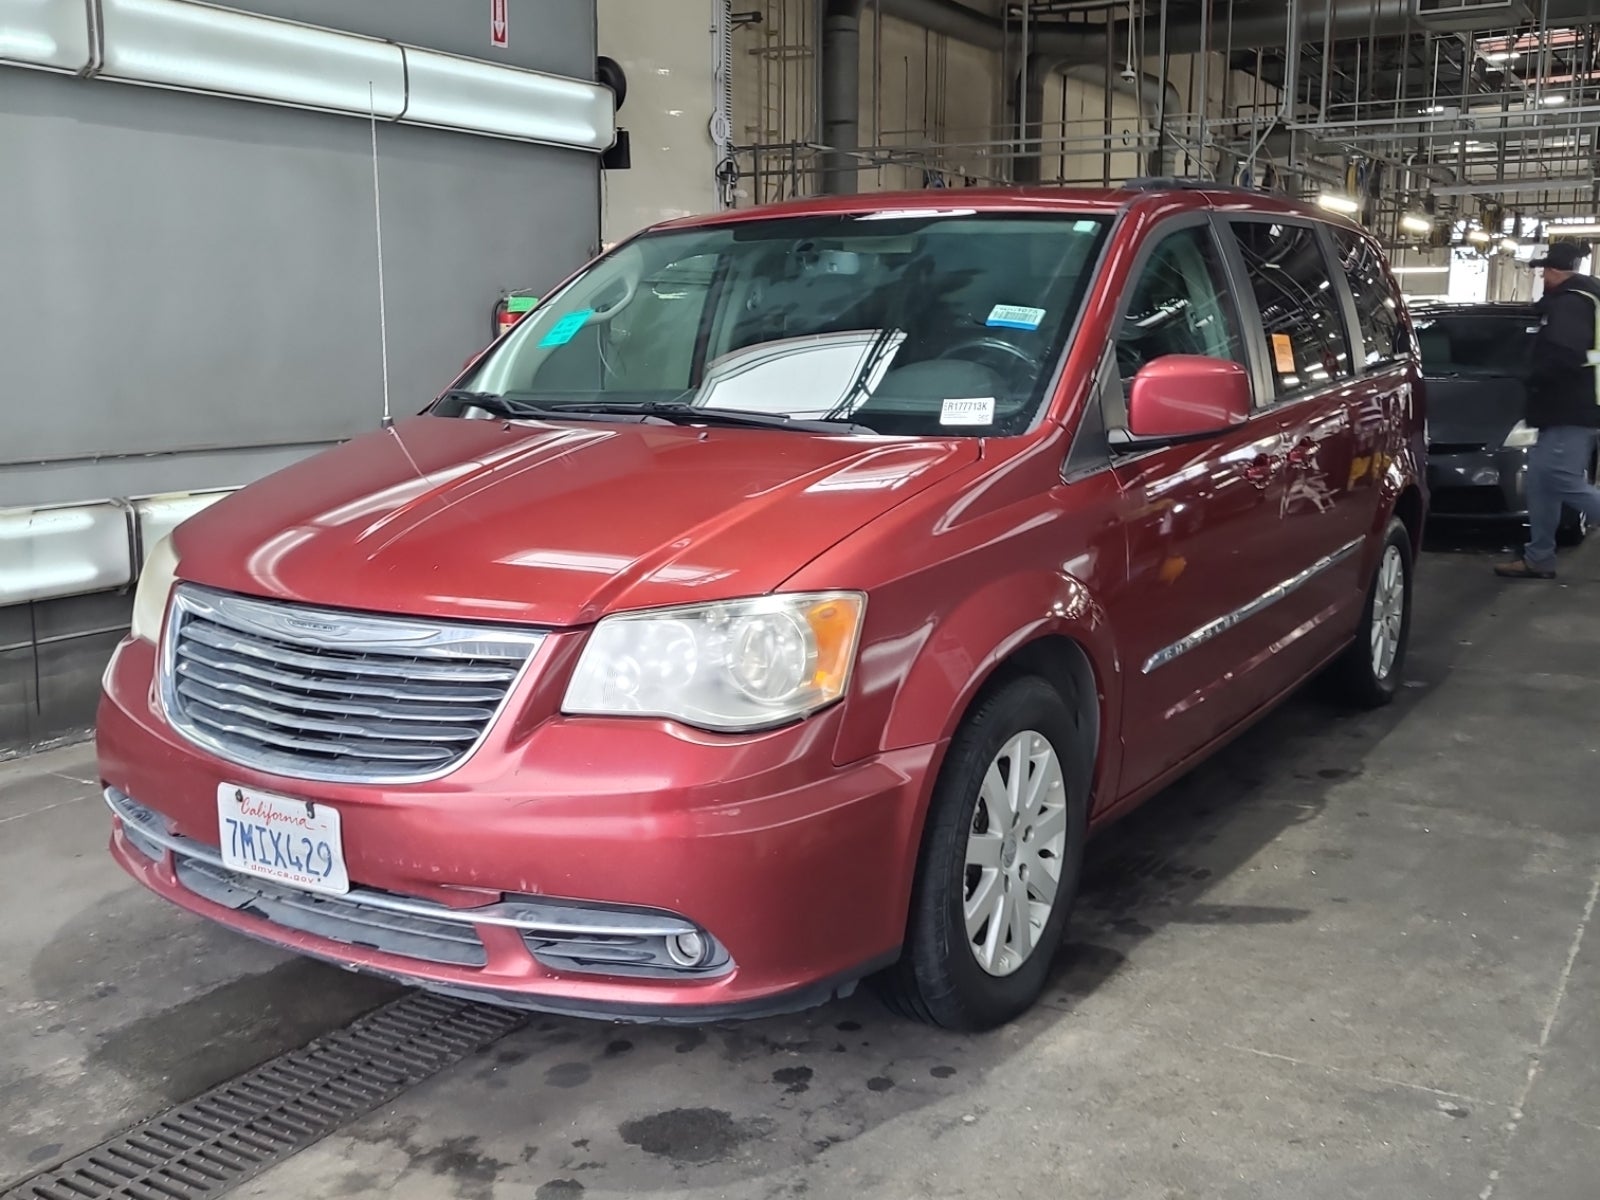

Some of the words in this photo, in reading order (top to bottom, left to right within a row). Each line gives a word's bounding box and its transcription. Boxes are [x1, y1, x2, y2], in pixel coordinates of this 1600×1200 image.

[947, 401, 988, 411] R177713K
[240, 797, 315, 830] California
[226, 818, 332, 877] 7MIX429
[250, 863, 314, 884] dmv.ca.gov
